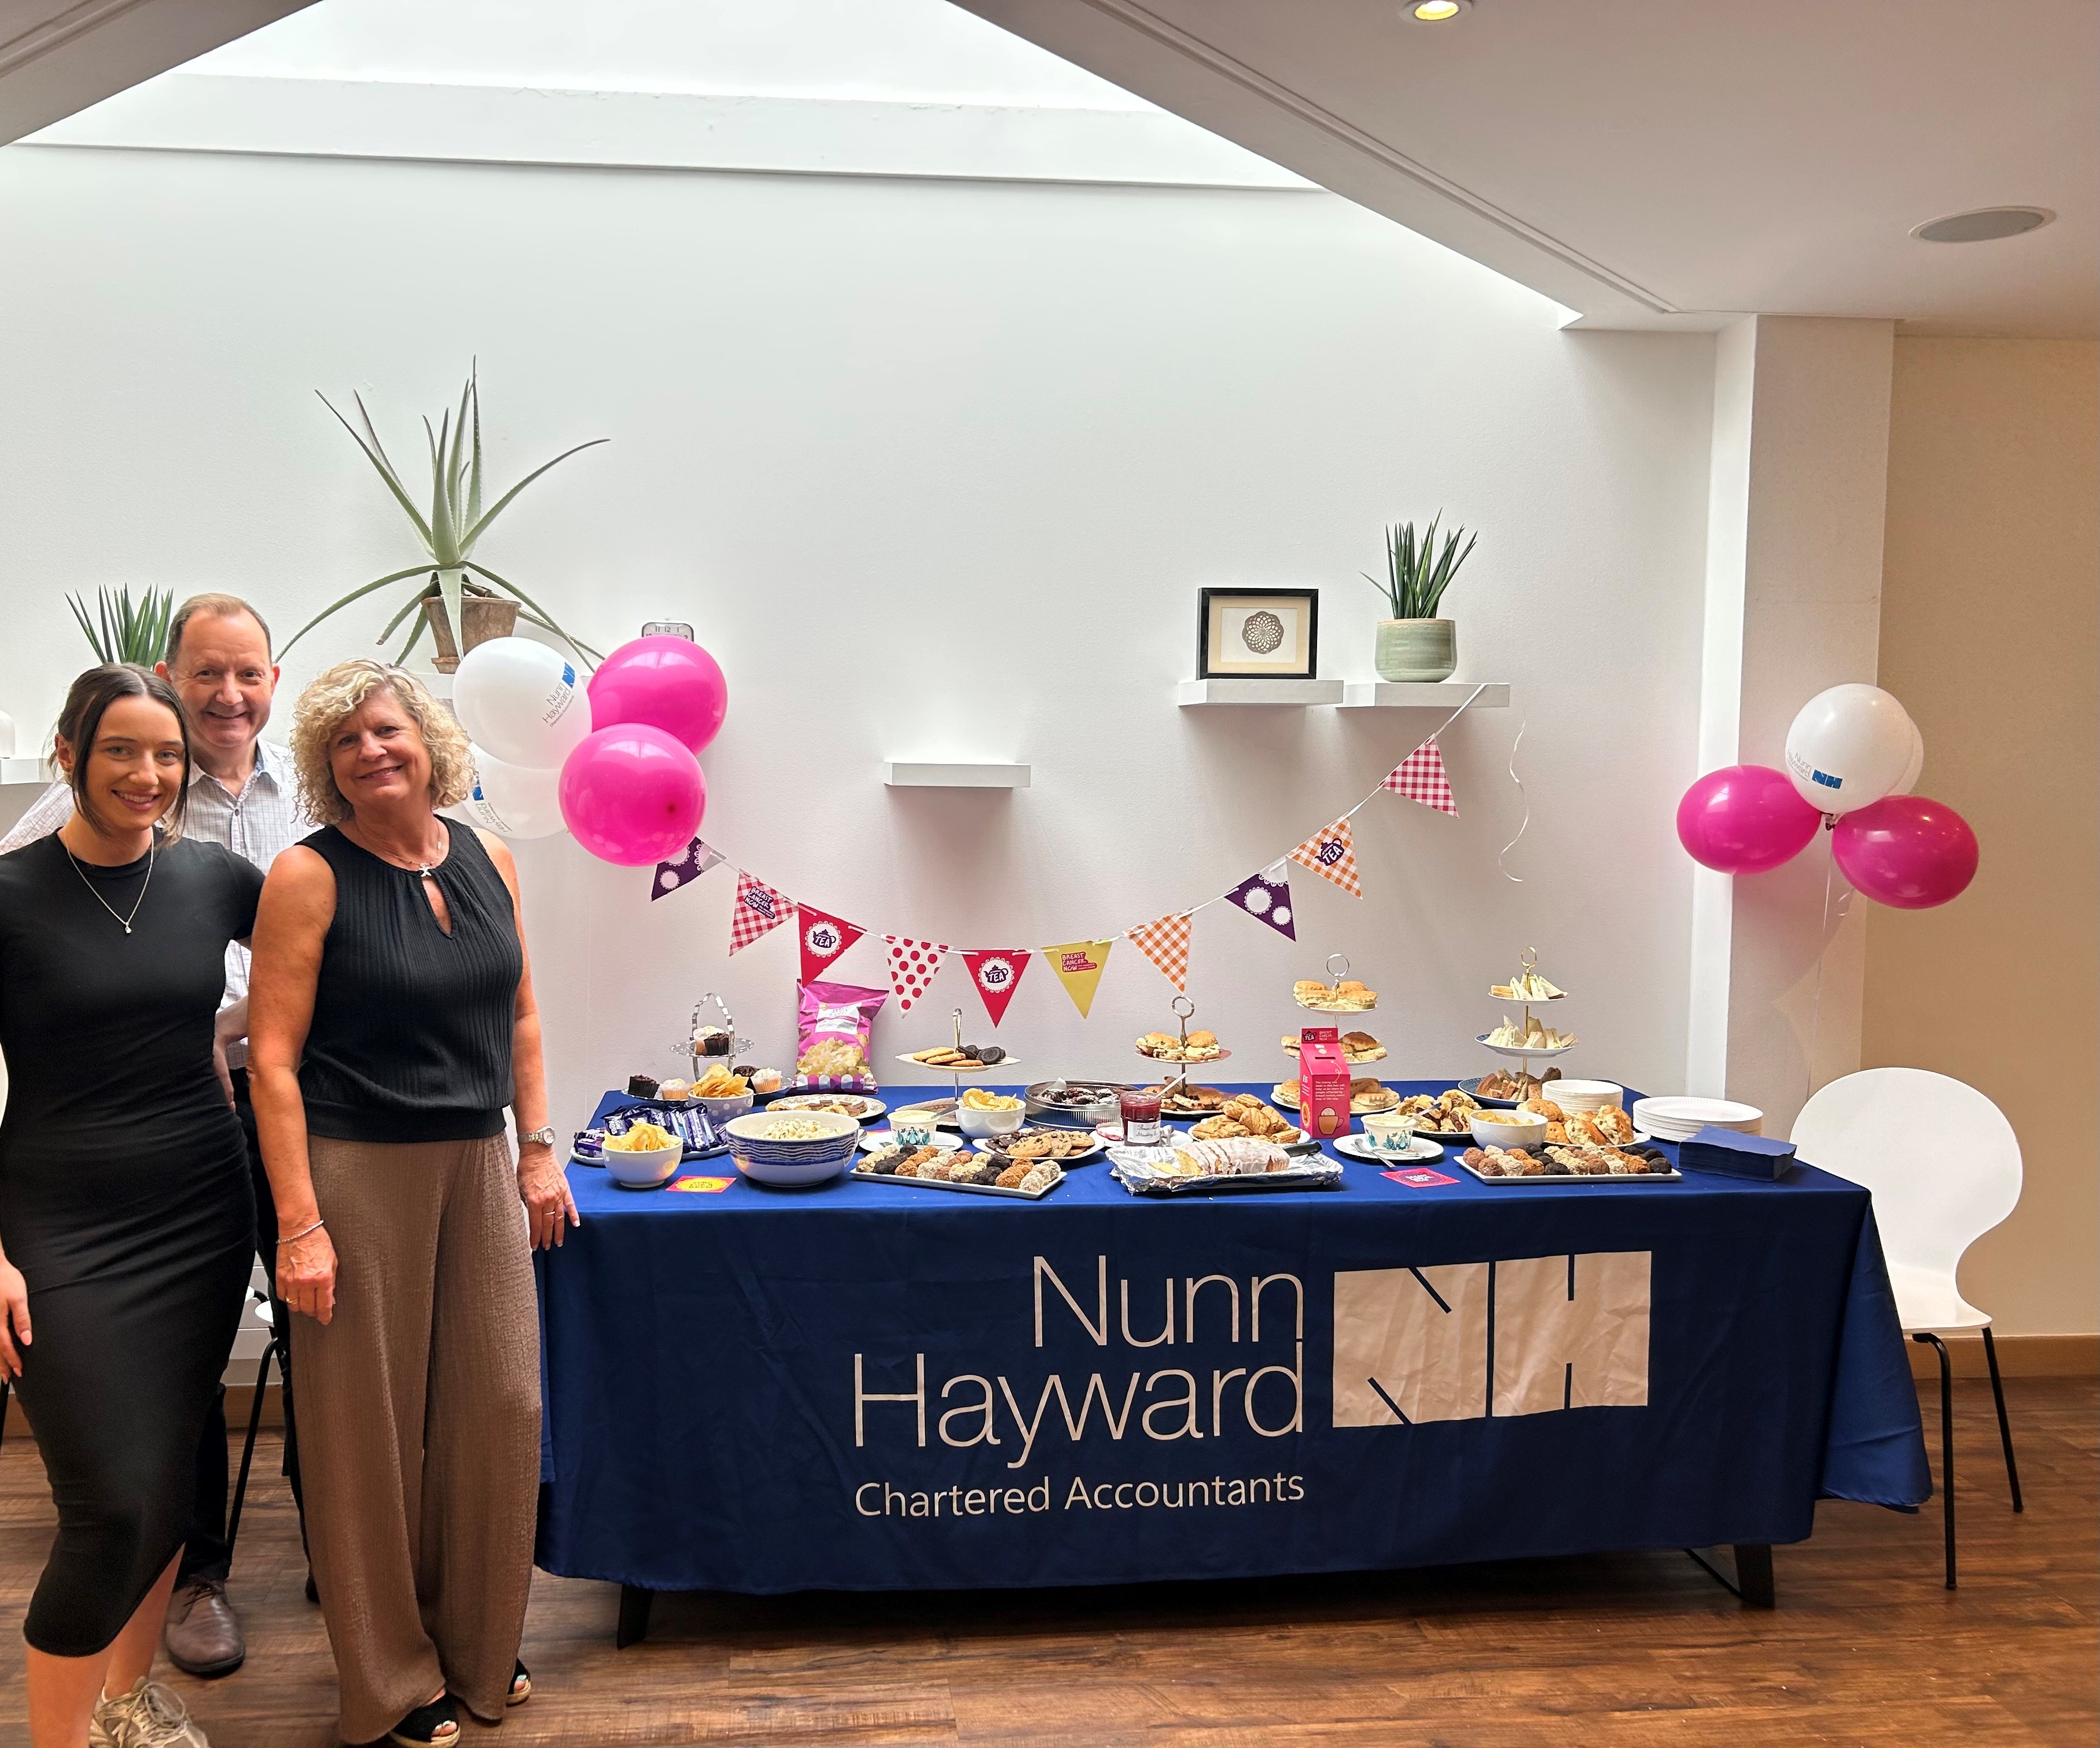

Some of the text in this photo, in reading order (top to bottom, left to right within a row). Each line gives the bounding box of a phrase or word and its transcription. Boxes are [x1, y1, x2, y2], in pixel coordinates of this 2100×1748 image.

[546, 682, 568, 706] Nunn
[542, 687, 571, 724] Hayward
[1322, 846, 1343, 864] TEA
[744, 897, 759, 908] NOW
[748, 893, 769, 909] CANCER
[751, 887, 773, 902] BREAST
[815, 936, 830, 948] TEA
[1062, 952, 1085, 961] BREAST
[1062, 958, 1087, 966] CANCER
[988, 972, 1005, 982] TEA
[1034, 1255, 1303, 1347] Nunn
[855, 1341, 1303, 1469] Hayward
[855, 1472, 1304, 1517] Chartered Accountants
